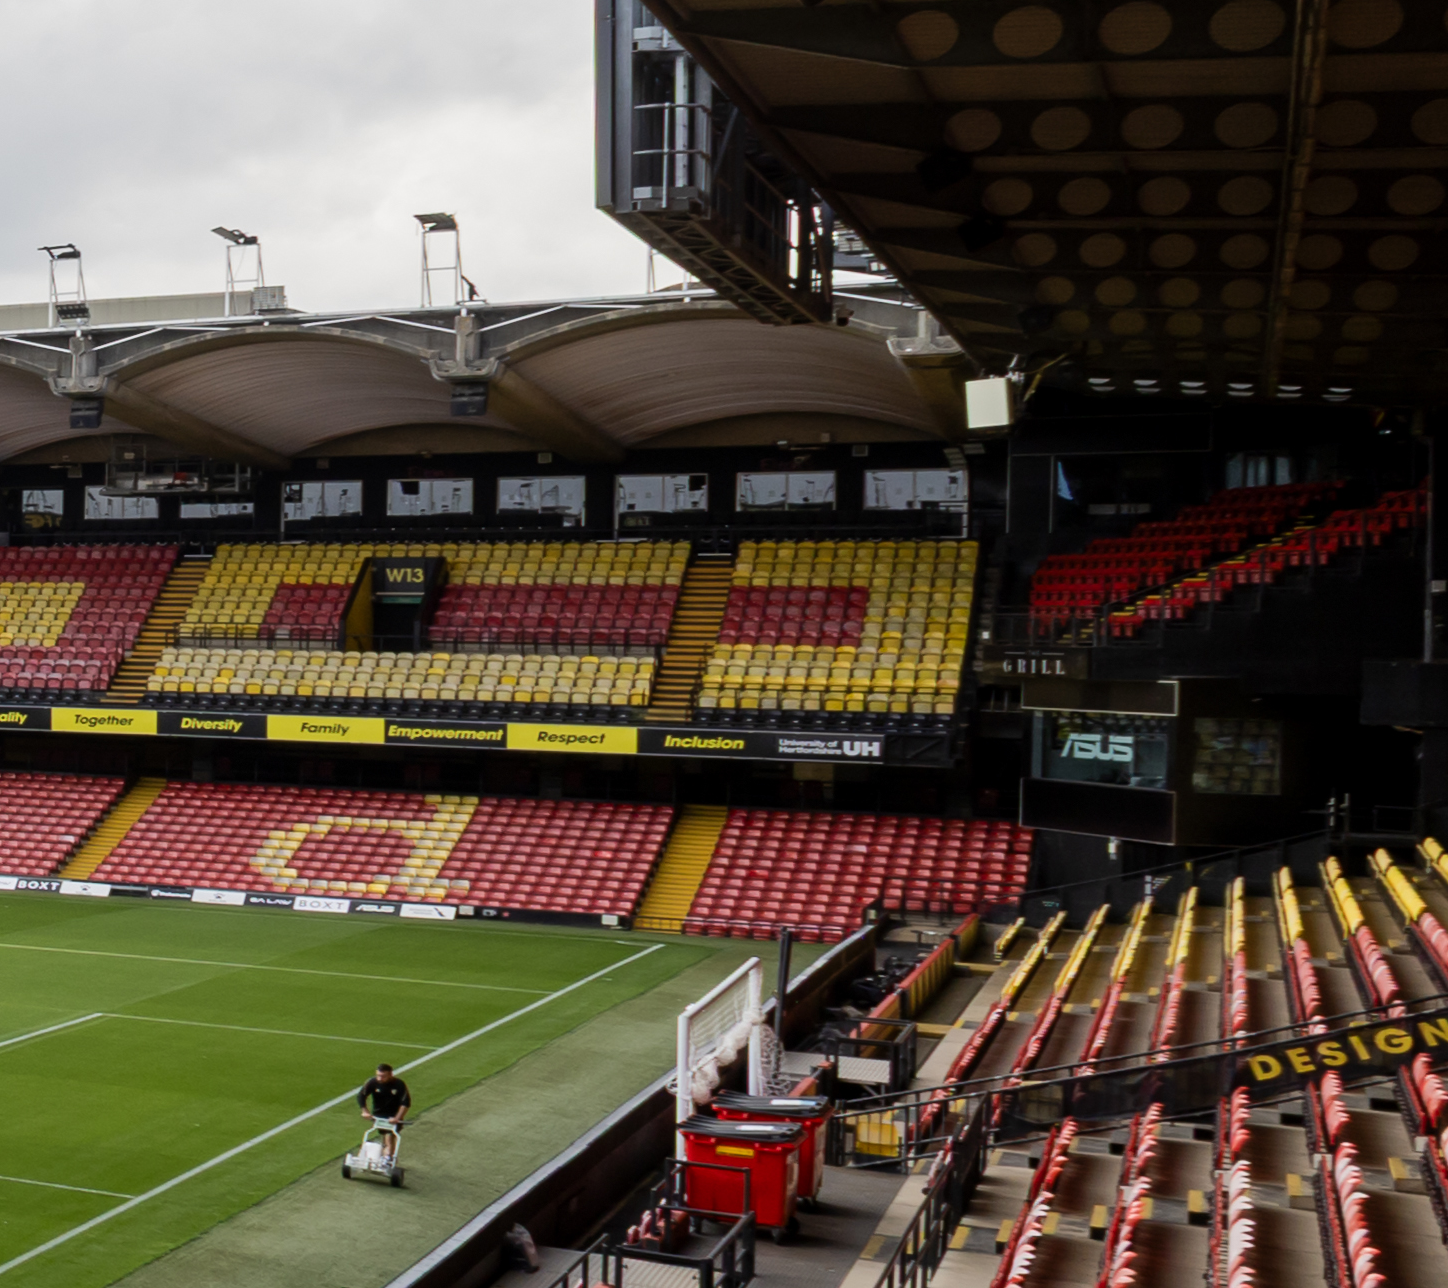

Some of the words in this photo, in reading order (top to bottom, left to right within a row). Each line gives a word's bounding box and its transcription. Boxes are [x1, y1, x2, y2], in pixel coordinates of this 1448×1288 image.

[386, 567, 425, 583] W13
[1003, 658, 1065, 675] GRILL
[74, 714, 134, 727] Together
[180, 717, 244, 733] Diversity
[300, 721, 350, 736] Family
[388, 724, 504, 740] Empowerment
[536, 731, 606, 745] Respect
[664, 735, 745, 749] Inclusion
[842, 740, 881, 757] UH
[1060, 732, 1134, 762] ASUS
[17, 879, 61, 891] BOXT
[298, 899, 345, 910] BOXT
[1247, 1017, 1448, 1082] DESIGN
